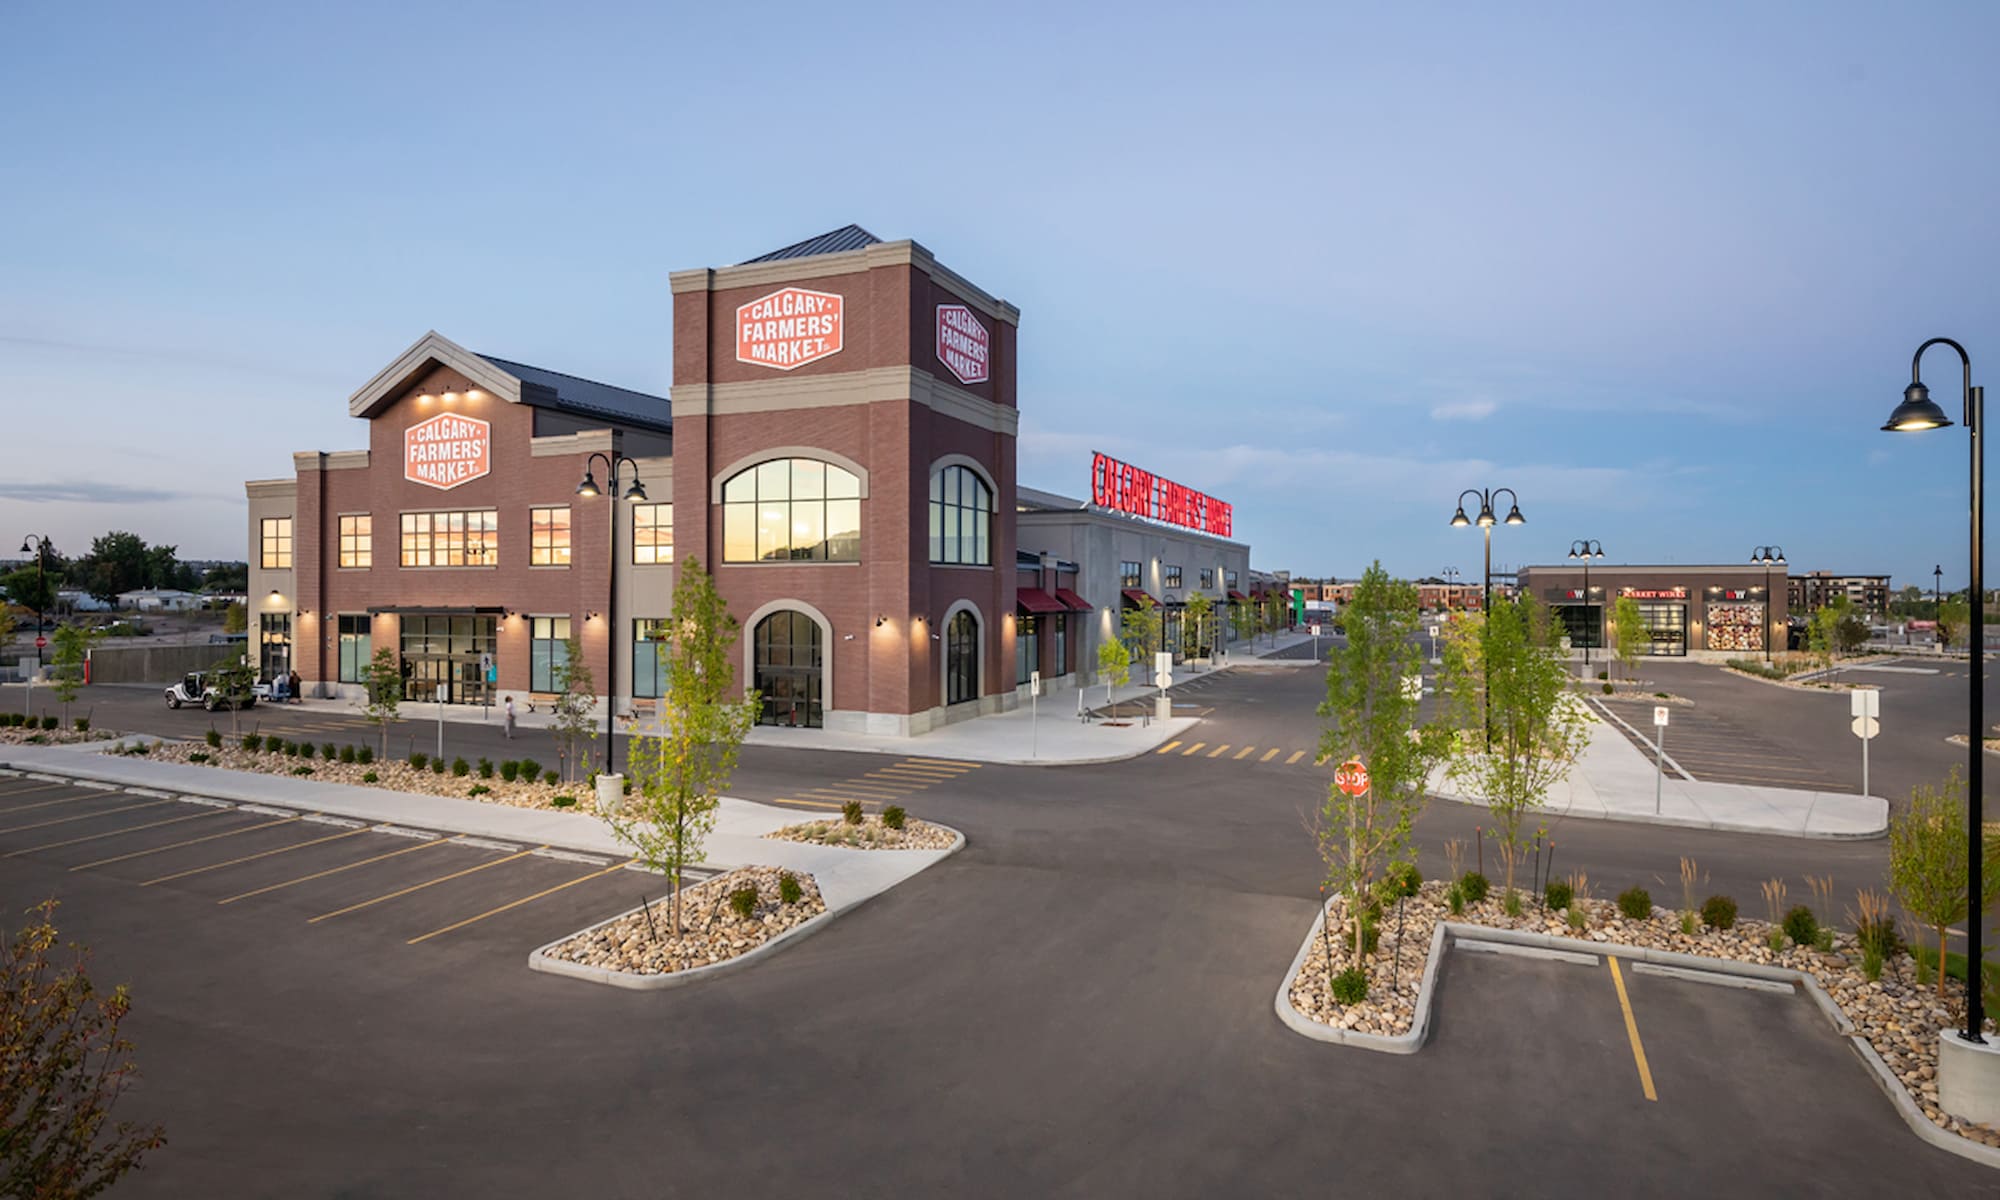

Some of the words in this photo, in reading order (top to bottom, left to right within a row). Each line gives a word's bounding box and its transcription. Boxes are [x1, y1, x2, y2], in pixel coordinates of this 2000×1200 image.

[751, 293, 826, 320] CALGARY
[743, 313, 839, 343] FARMERS'
[946, 311, 981, 341] CALGARY
[752, 338, 825, 364] MARKET
[946, 348, 982, 378] MARKET
[417, 418, 476, 442] CALGARY
[410, 439, 486, 463] FARMERS'
[417, 460, 476, 484] MARKET
[1092, 453, 1154, 518] CALGARY
